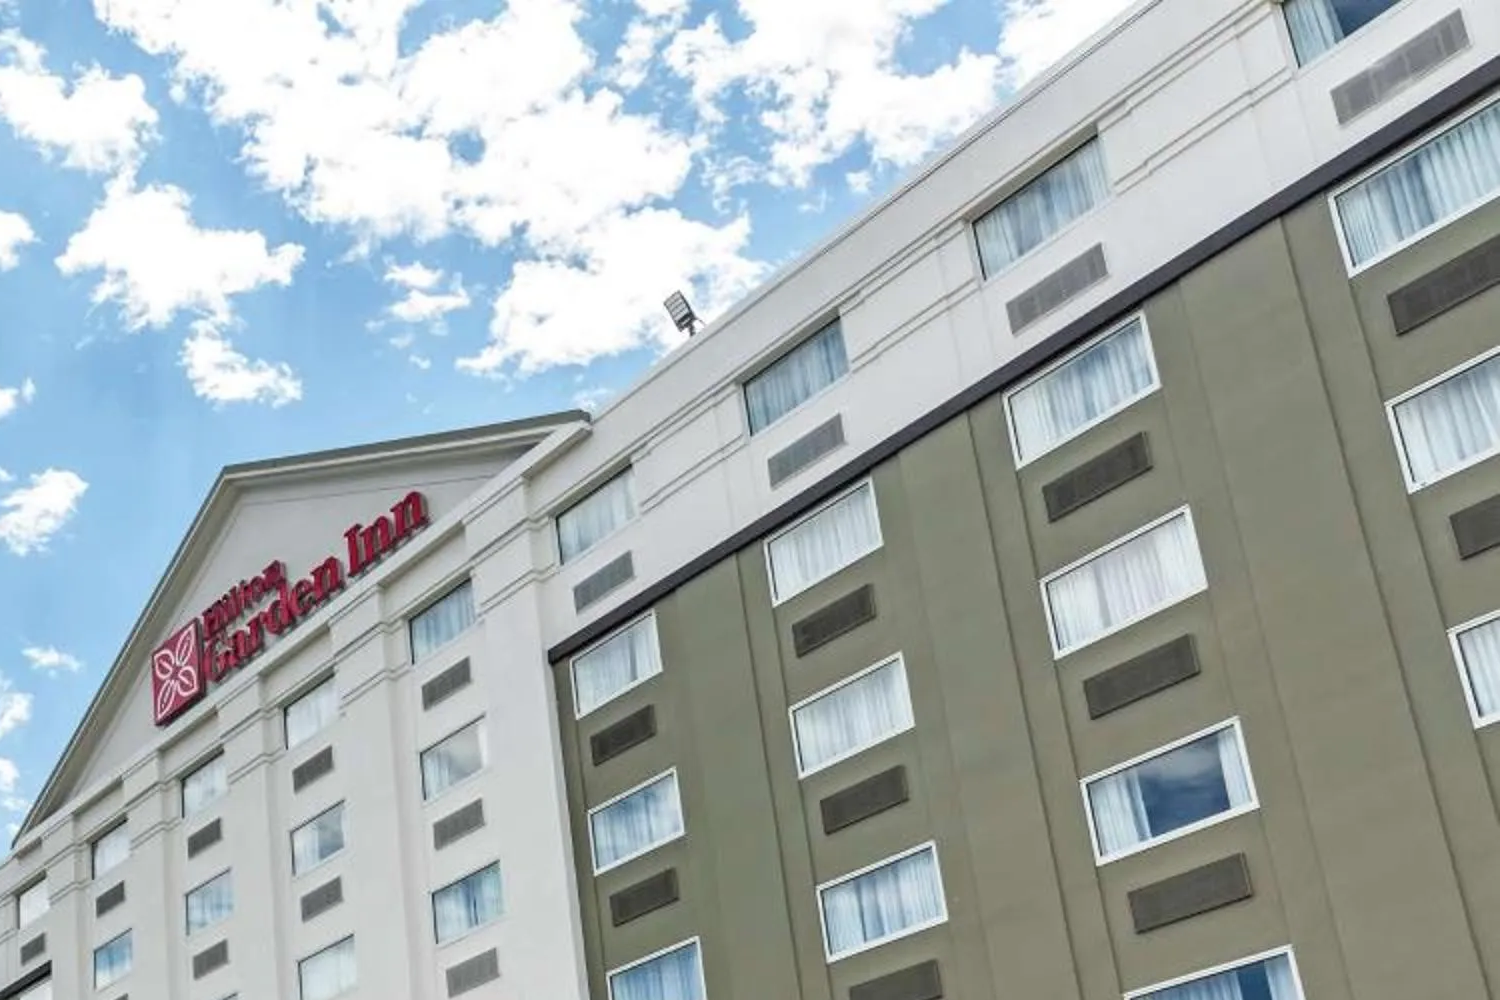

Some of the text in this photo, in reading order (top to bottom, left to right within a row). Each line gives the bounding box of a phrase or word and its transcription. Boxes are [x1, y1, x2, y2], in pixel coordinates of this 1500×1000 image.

[202, 491, 430, 682] Garden Inn
[202, 559, 286, 639] Hilton
